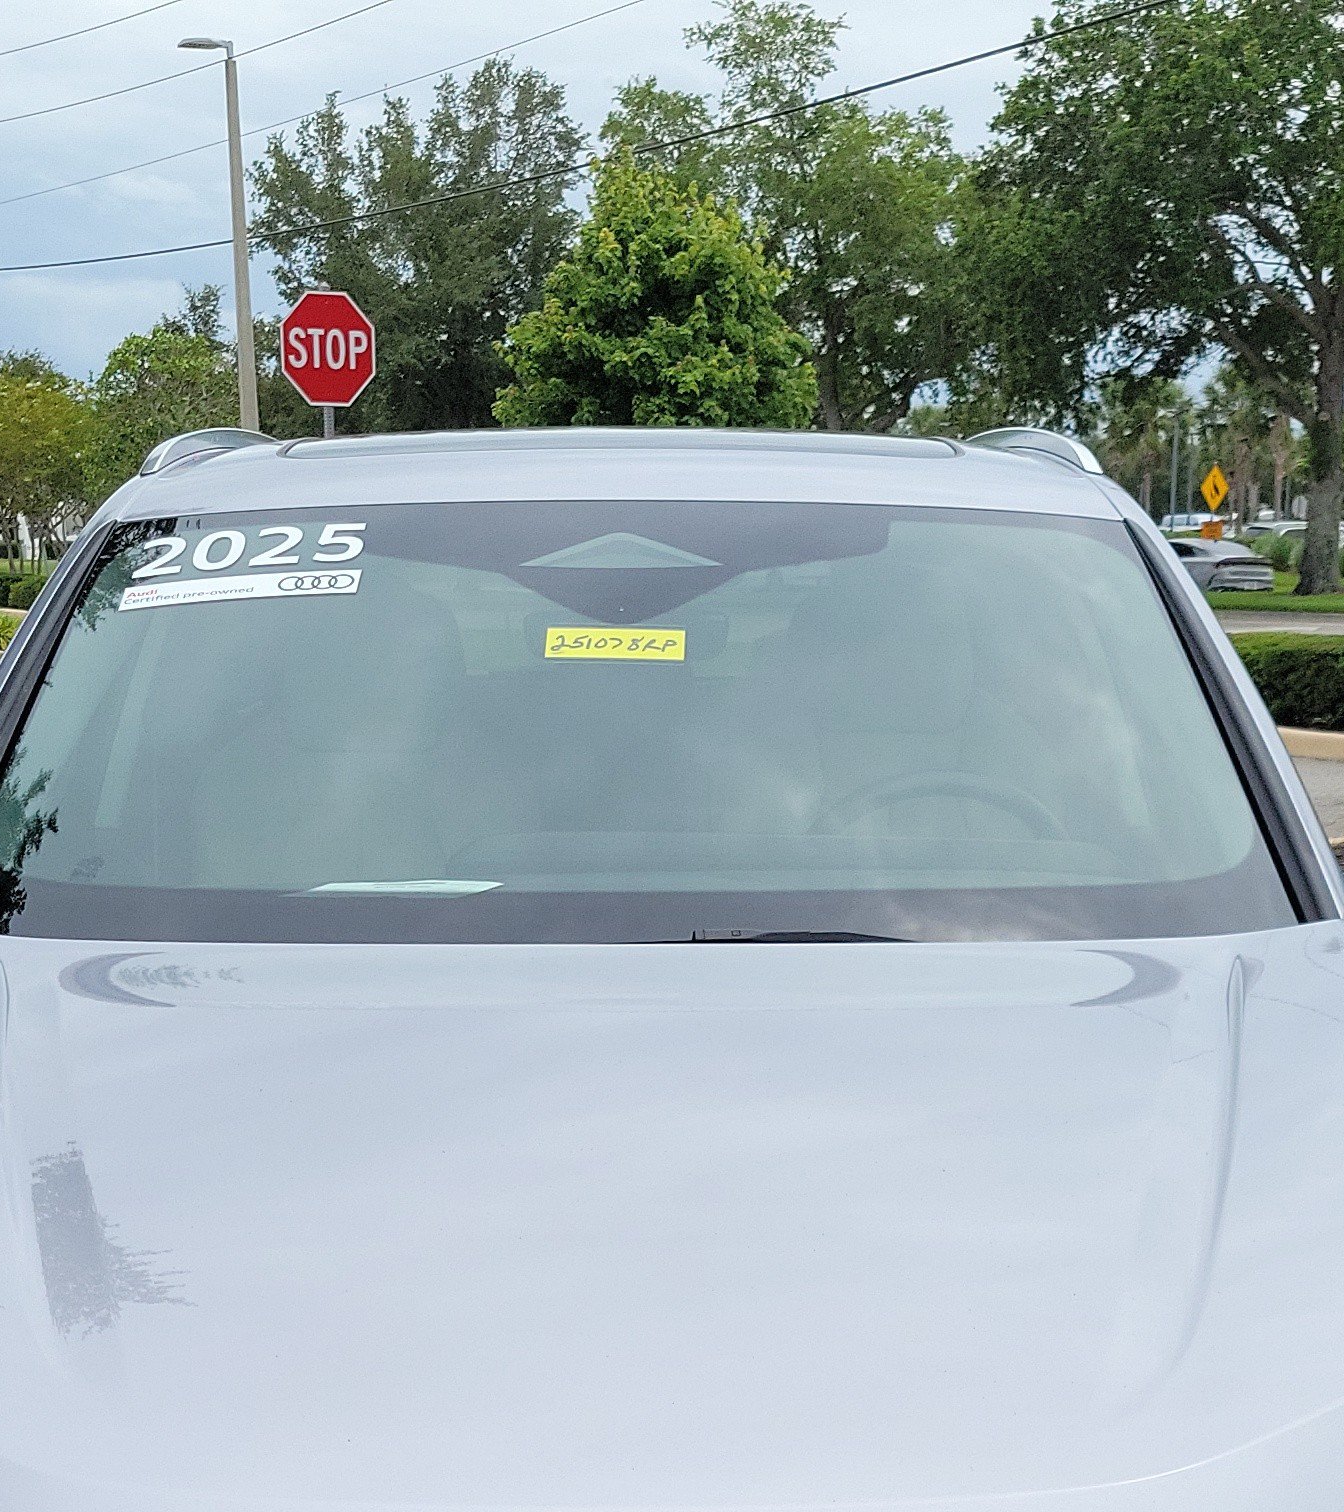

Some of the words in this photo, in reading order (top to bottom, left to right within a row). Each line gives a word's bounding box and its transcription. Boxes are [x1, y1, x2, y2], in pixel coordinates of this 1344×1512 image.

[288, 327, 368, 370] STOP
[132, 522, 367, 579] 2025
[124, 593, 179, 605] Certified
[183, 586, 255, 599] pre-owned
[127, 589, 158, 598] Audi
